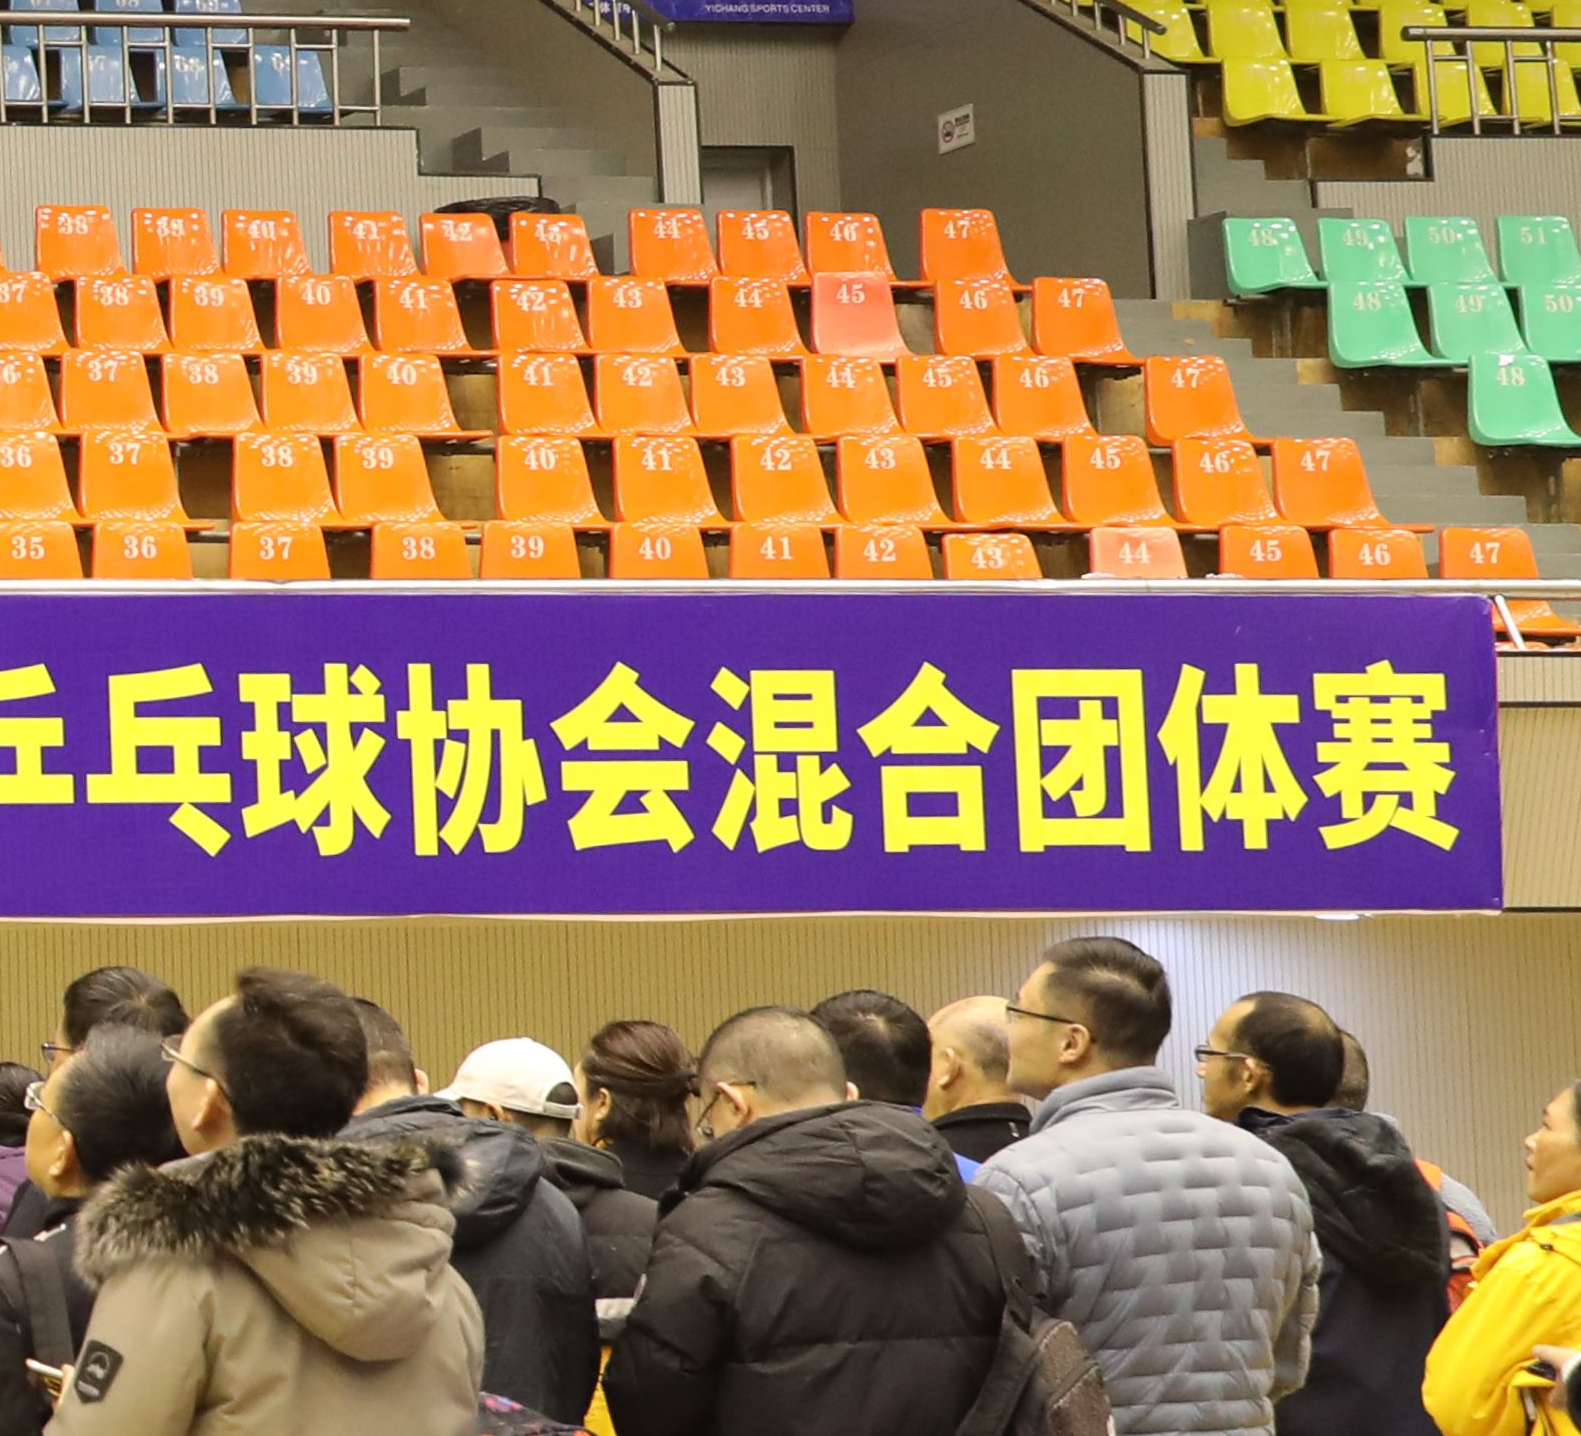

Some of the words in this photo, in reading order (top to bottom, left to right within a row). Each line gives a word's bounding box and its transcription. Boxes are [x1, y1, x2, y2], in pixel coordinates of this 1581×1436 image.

[790, 4, 831, 14] CENTER
[1341, 228, 1369, 247] 49
[1518, 227, 1547, 245] 51
[194, 287, 224, 306] 39
[301, 285, 331, 305] 40
[612, 288, 642, 308] 43
[836, 285, 866, 304] 45
[1057, 289, 1085, 308] 47
[1351, 291, 1381, 311] 48
[1454, 294, 1483, 314] 49
[89, 361, 119, 381] 37
[189, 364, 219, 384] 38
[386, 365, 416, 385] 40
[523, 366, 553, 386] 41
[716, 366, 745, 386] 43
[1018, 368, 1049, 388] 46
[1171, 368, 1200, 389] 47
[1494, 366, 1525, 386] 48
[0, 446, 31, 468] 36
[109, 443, 140, 465] 37
[261, 446, 293, 467] 38
[362, 447, 393, 469] 39
[525, 449, 556, 470] 40
[642, 449, 673, 471] 41
[760, 449, 792, 471] 42
[864, 447, 896, 469] 43
[980, 447, 1012, 469] 44
[1090, 448, 1121, 469] 45
[1199, 452, 1231, 473] 46
[1300, 449, 1332, 471] 47
[12, 537, 45, 559] 35
[124, 536, 157, 559] 36
[260, 537, 292, 560] 37
[403, 538, 435, 560] 38
[511, 536, 544, 559] 39
[639, 539, 671, 561] 40
[760, 537, 792, 560] 41
[863, 538, 897, 561] 42
[971, 546, 1004, 569] 43
[1118, 542, 1151, 563] 44
[1249, 540, 1281, 562] 45
[1358, 544, 1391, 565] 46
[1469, 541, 1500, 563] 47
